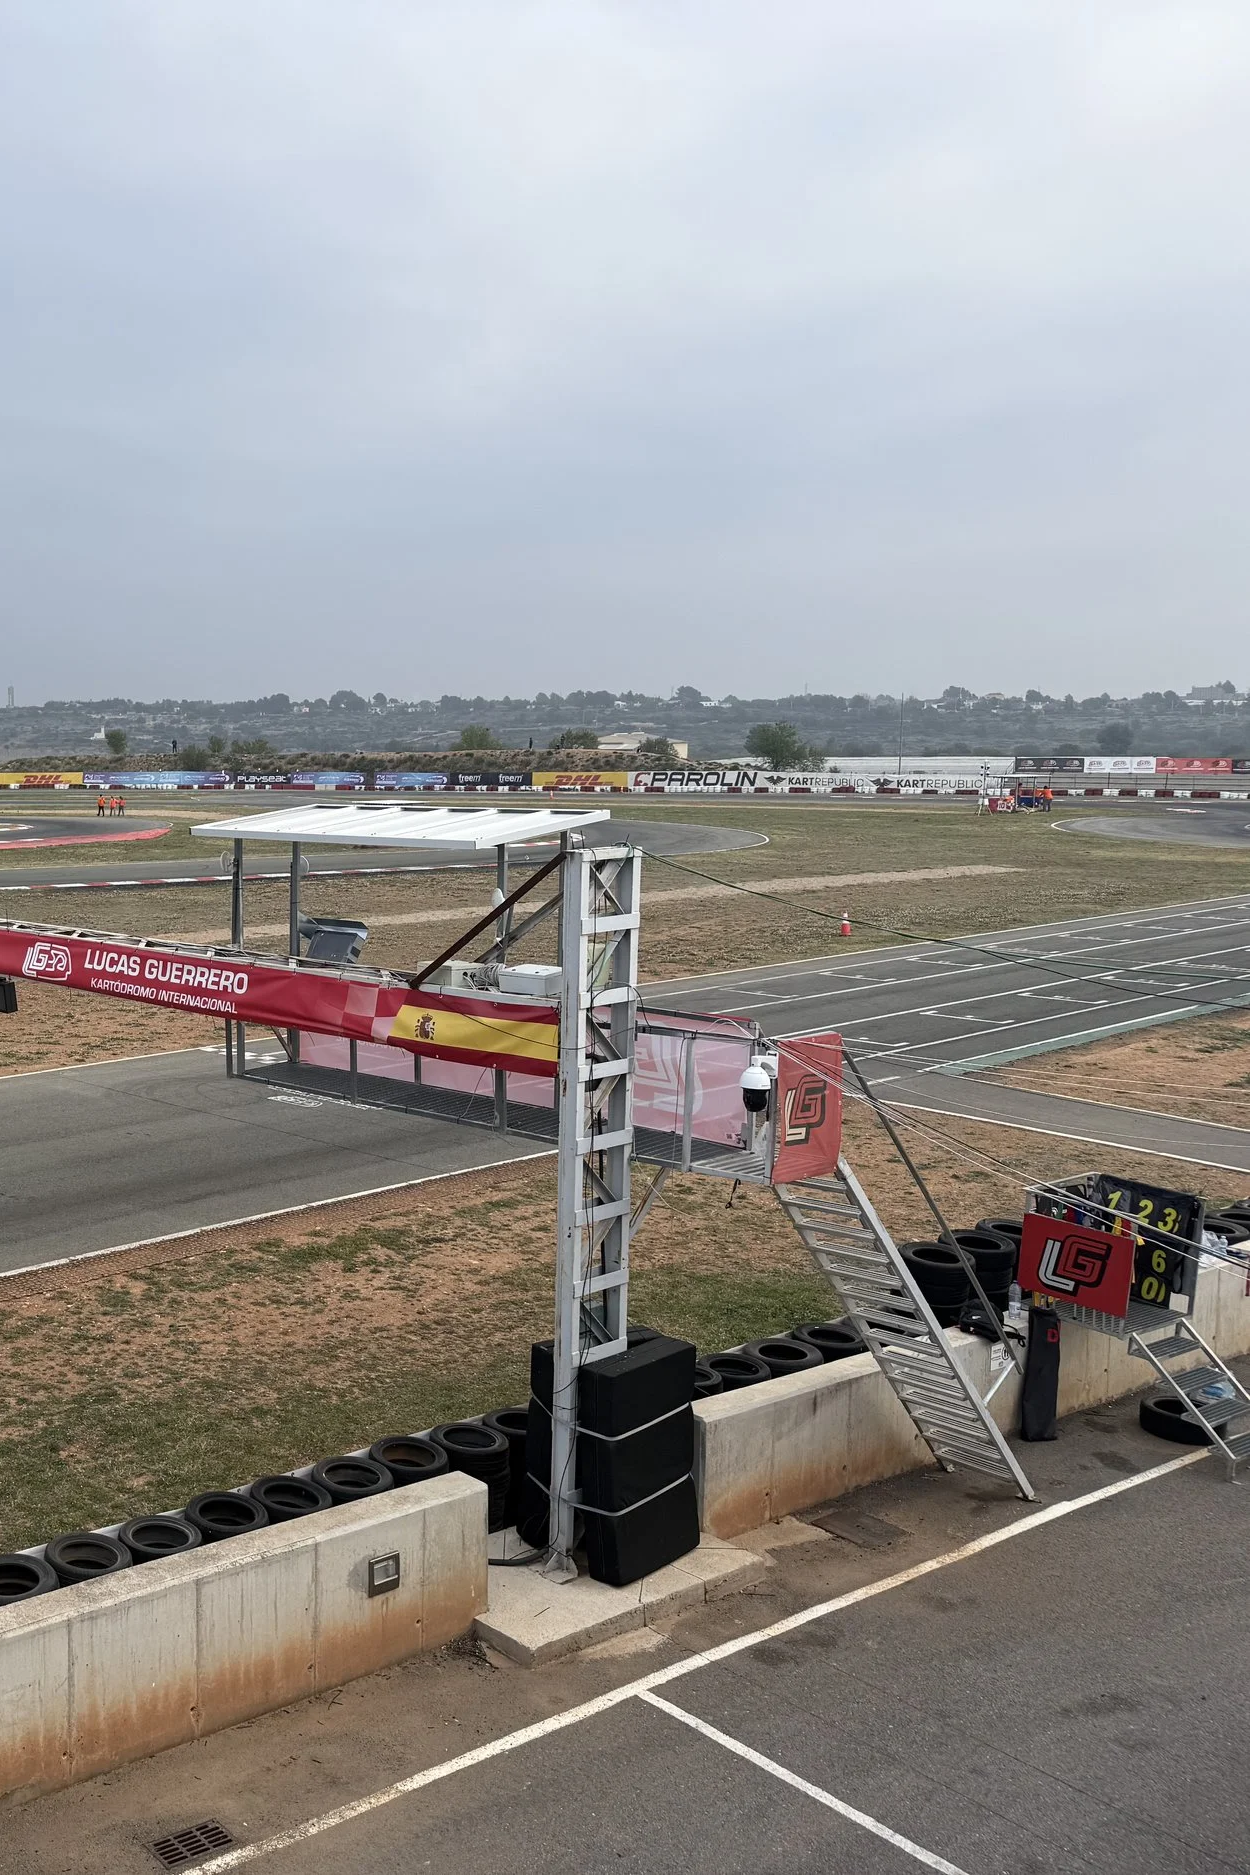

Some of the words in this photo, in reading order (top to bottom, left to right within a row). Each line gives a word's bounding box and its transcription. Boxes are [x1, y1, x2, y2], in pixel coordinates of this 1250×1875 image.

[23, 775, 64, 784] DHL
[458, 773, 481, 783] freem
[499, 773, 523, 783] freem
[554, 775, 603, 786] DHL
[650, 772, 758, 787] PAROLIN
[897, 779, 983, 789] KARTREPUBLIC
[84, 949, 141, 976] LUCAS
[145, 959, 249, 994] GUERRERO
[90, 977, 156, 999] KARTÓDROMO
[158, 990, 238, 1014] INTERNACIONAL
[1138, 1199, 1154, 1225] 2
[1157, 1207, 1177, 1232] 3
[1152, 1250, 1167, 1273] 6
